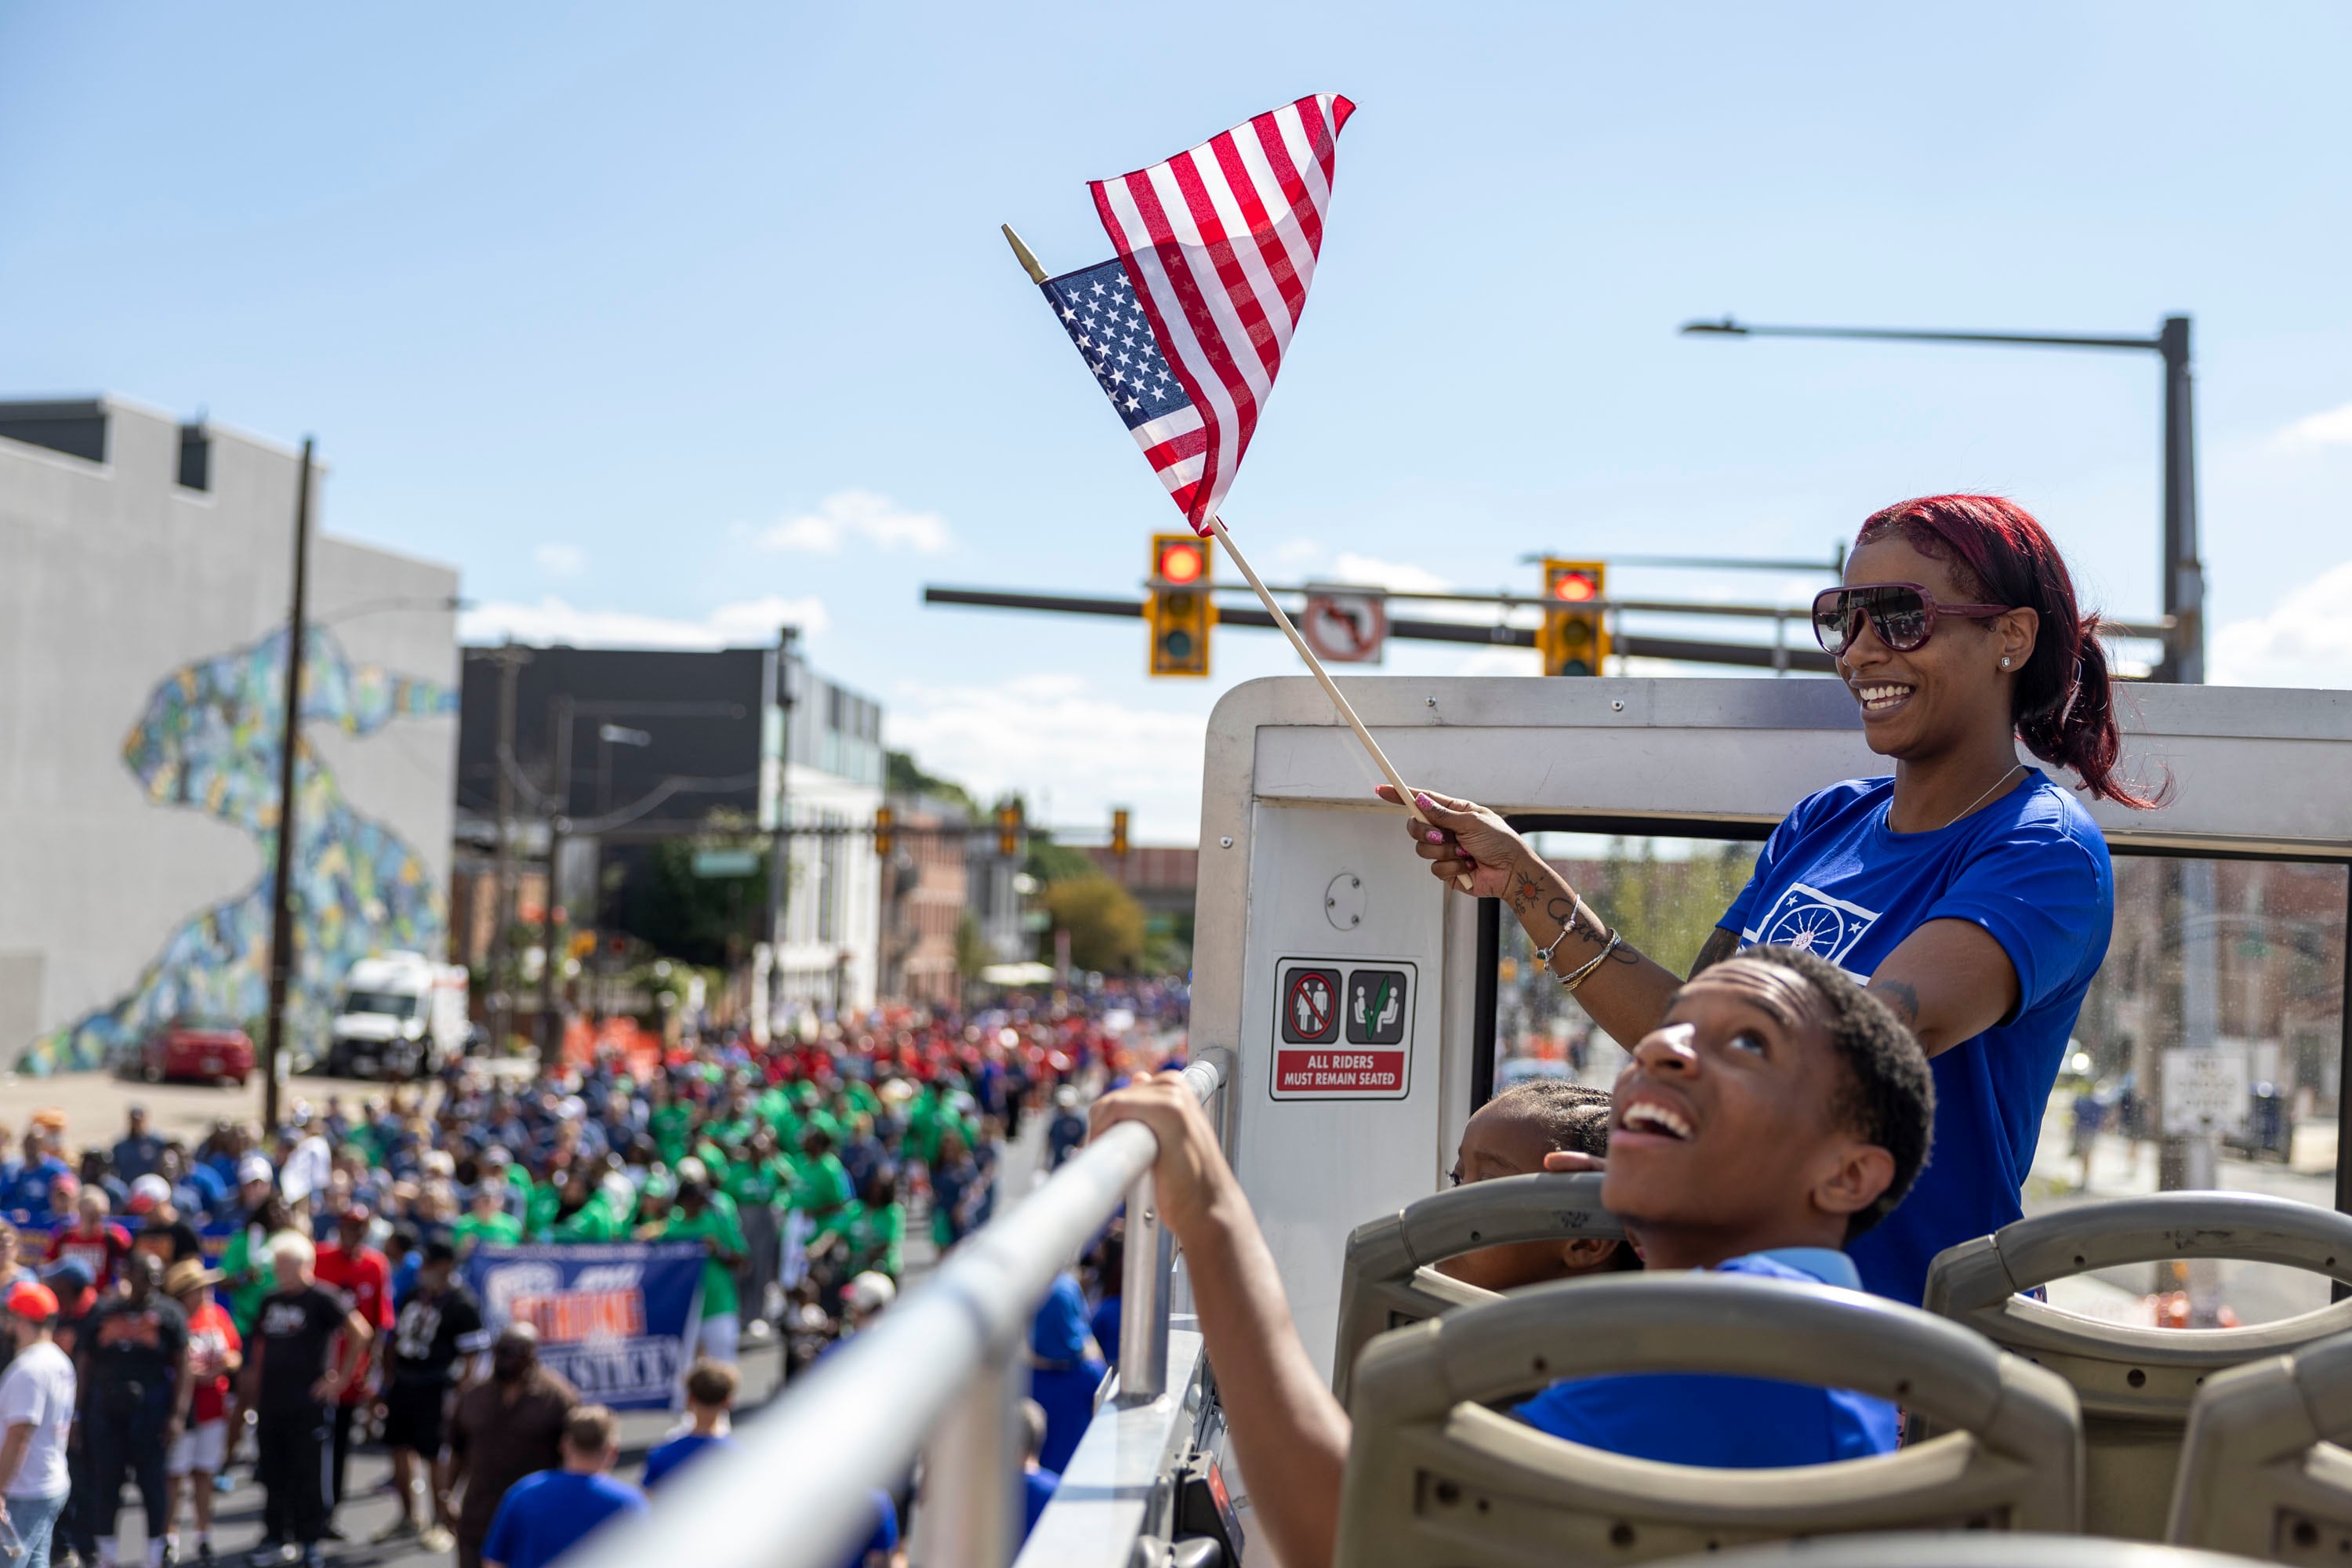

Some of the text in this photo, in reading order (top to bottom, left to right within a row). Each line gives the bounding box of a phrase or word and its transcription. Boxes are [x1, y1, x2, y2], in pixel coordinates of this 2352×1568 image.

[1307, 1054, 1374, 1069] ALL RIDERS
[1283, 1072, 1396, 1086] MUST REMAIN SEATED
